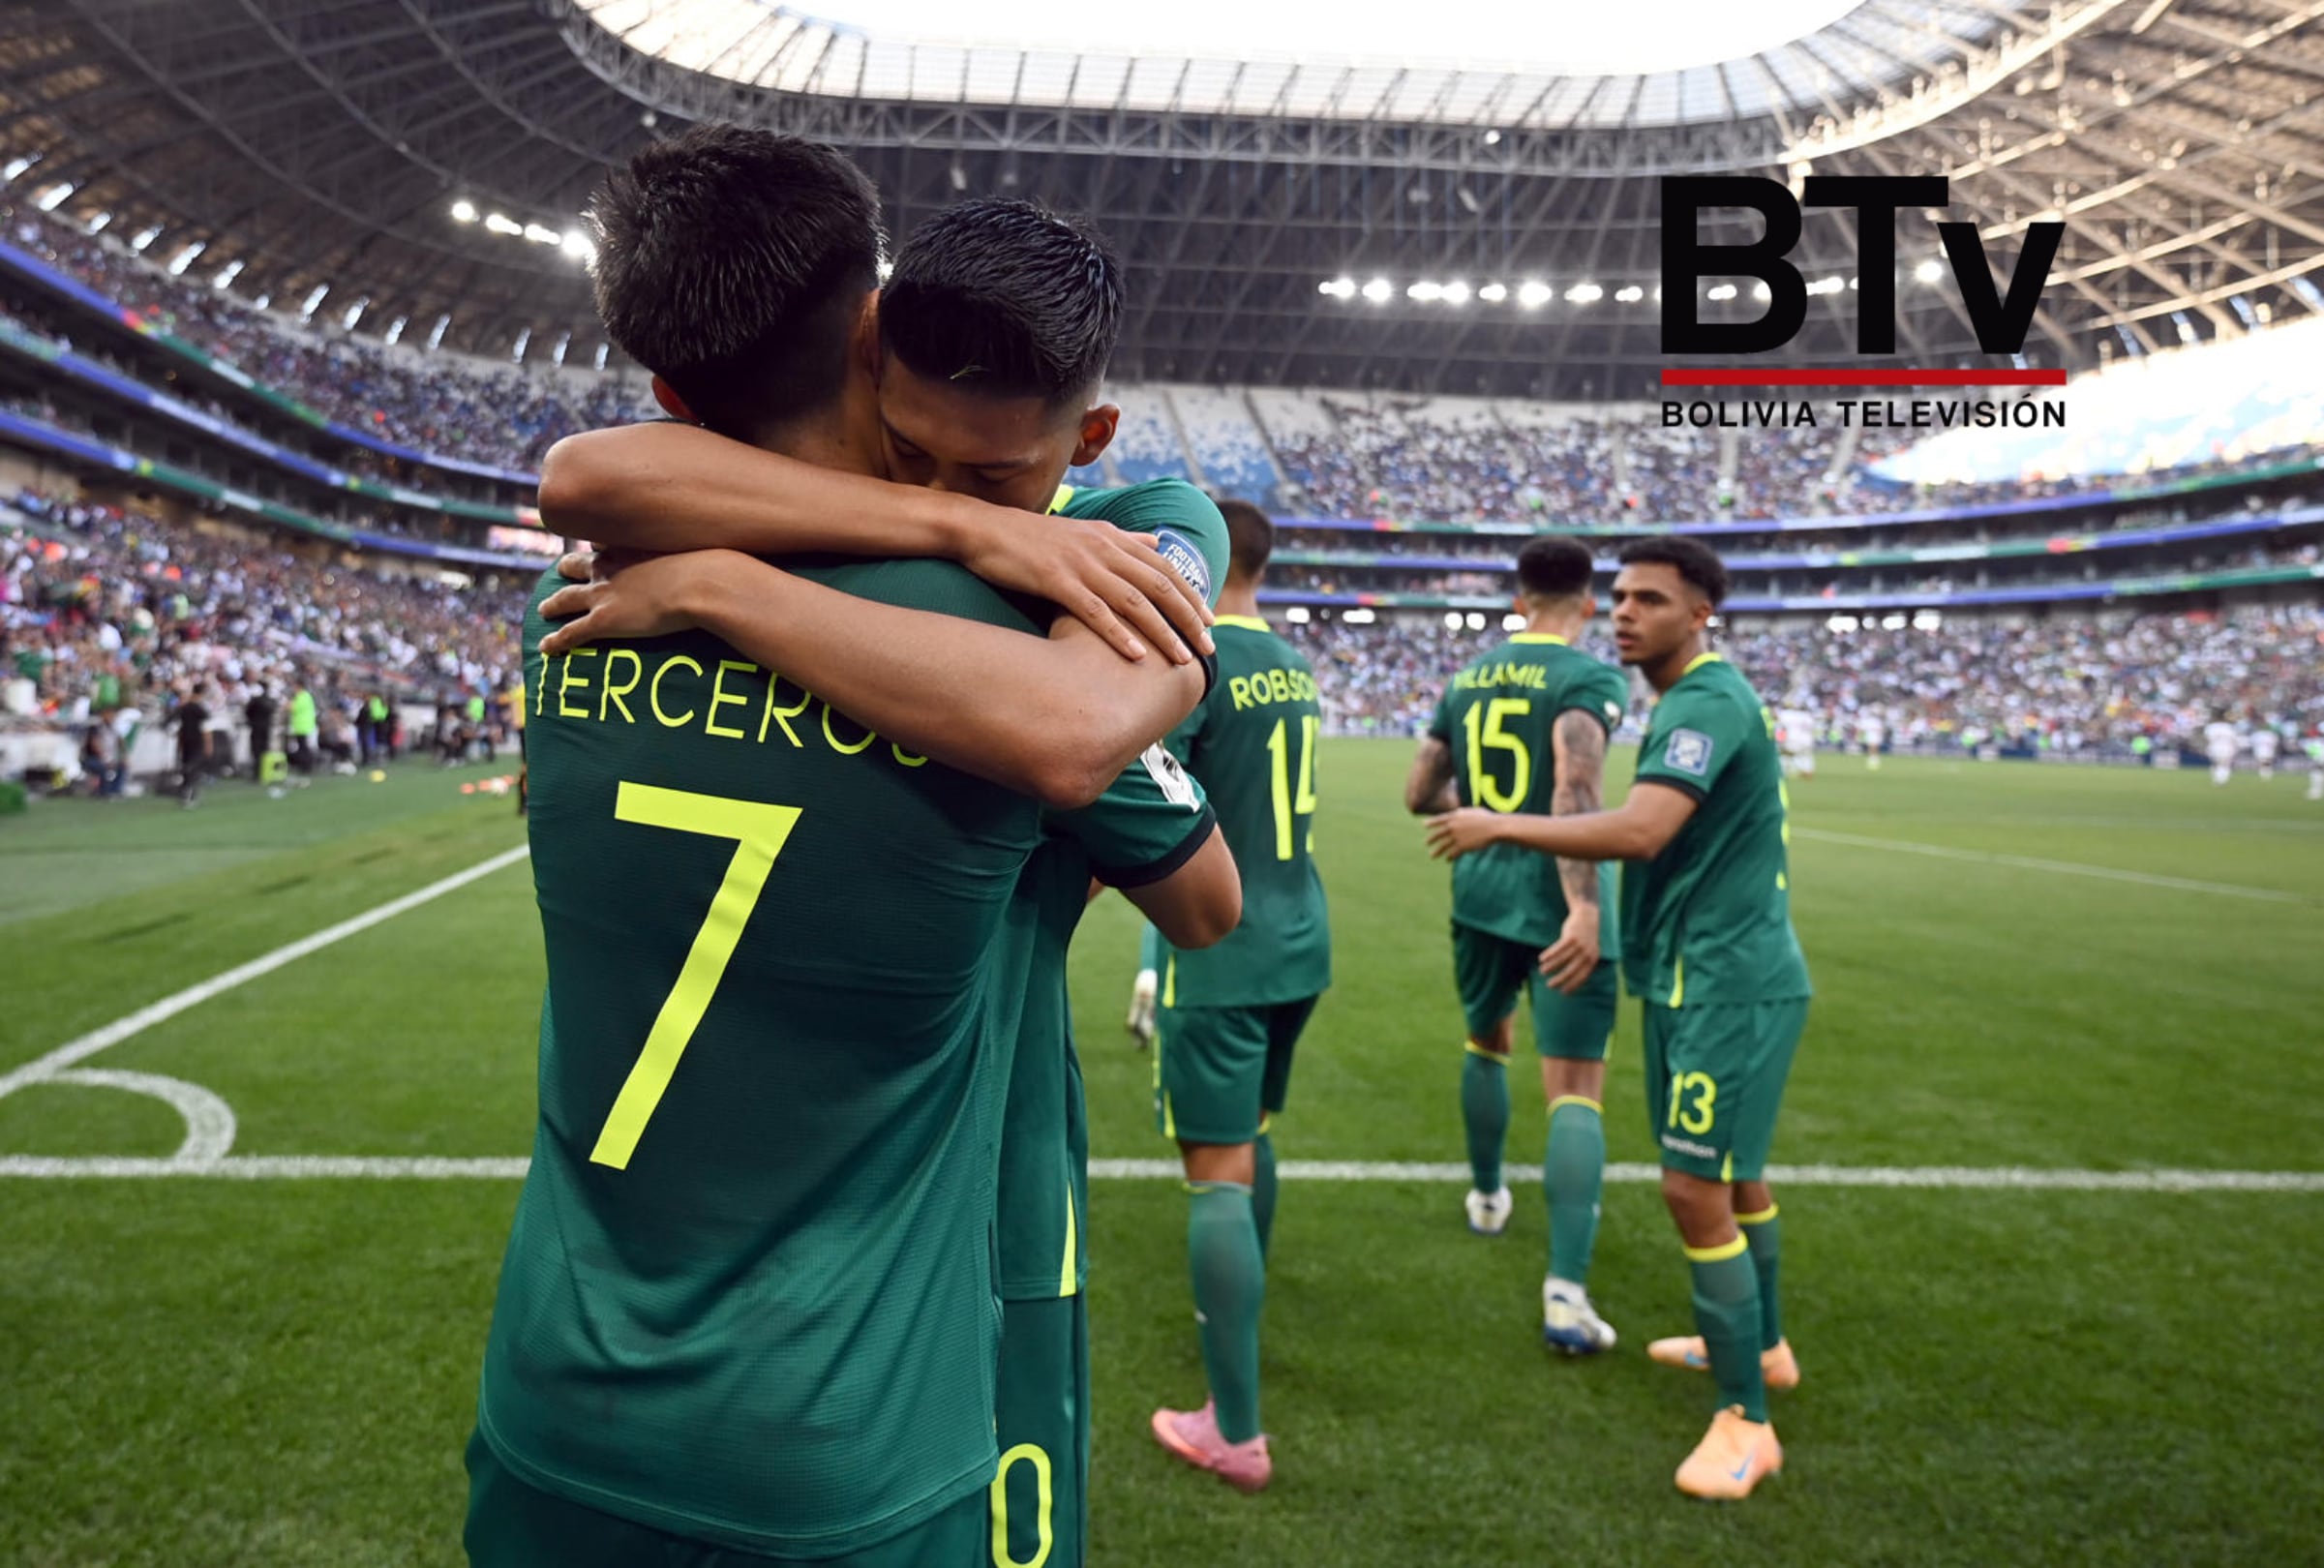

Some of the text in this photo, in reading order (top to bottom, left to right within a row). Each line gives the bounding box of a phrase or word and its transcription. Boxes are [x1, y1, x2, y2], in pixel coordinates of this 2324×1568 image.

[535, 648, 928, 767] TERCERO
[1229, 669, 1319, 711] ROBSO
[1266, 715, 1320, 860] 14
[1463, 698, 1530, 813] 15
[589, 780, 803, 1170] 7
[1668, 1070, 1717, 1134] 13
[990, 1443, 1053, 1568] 0
